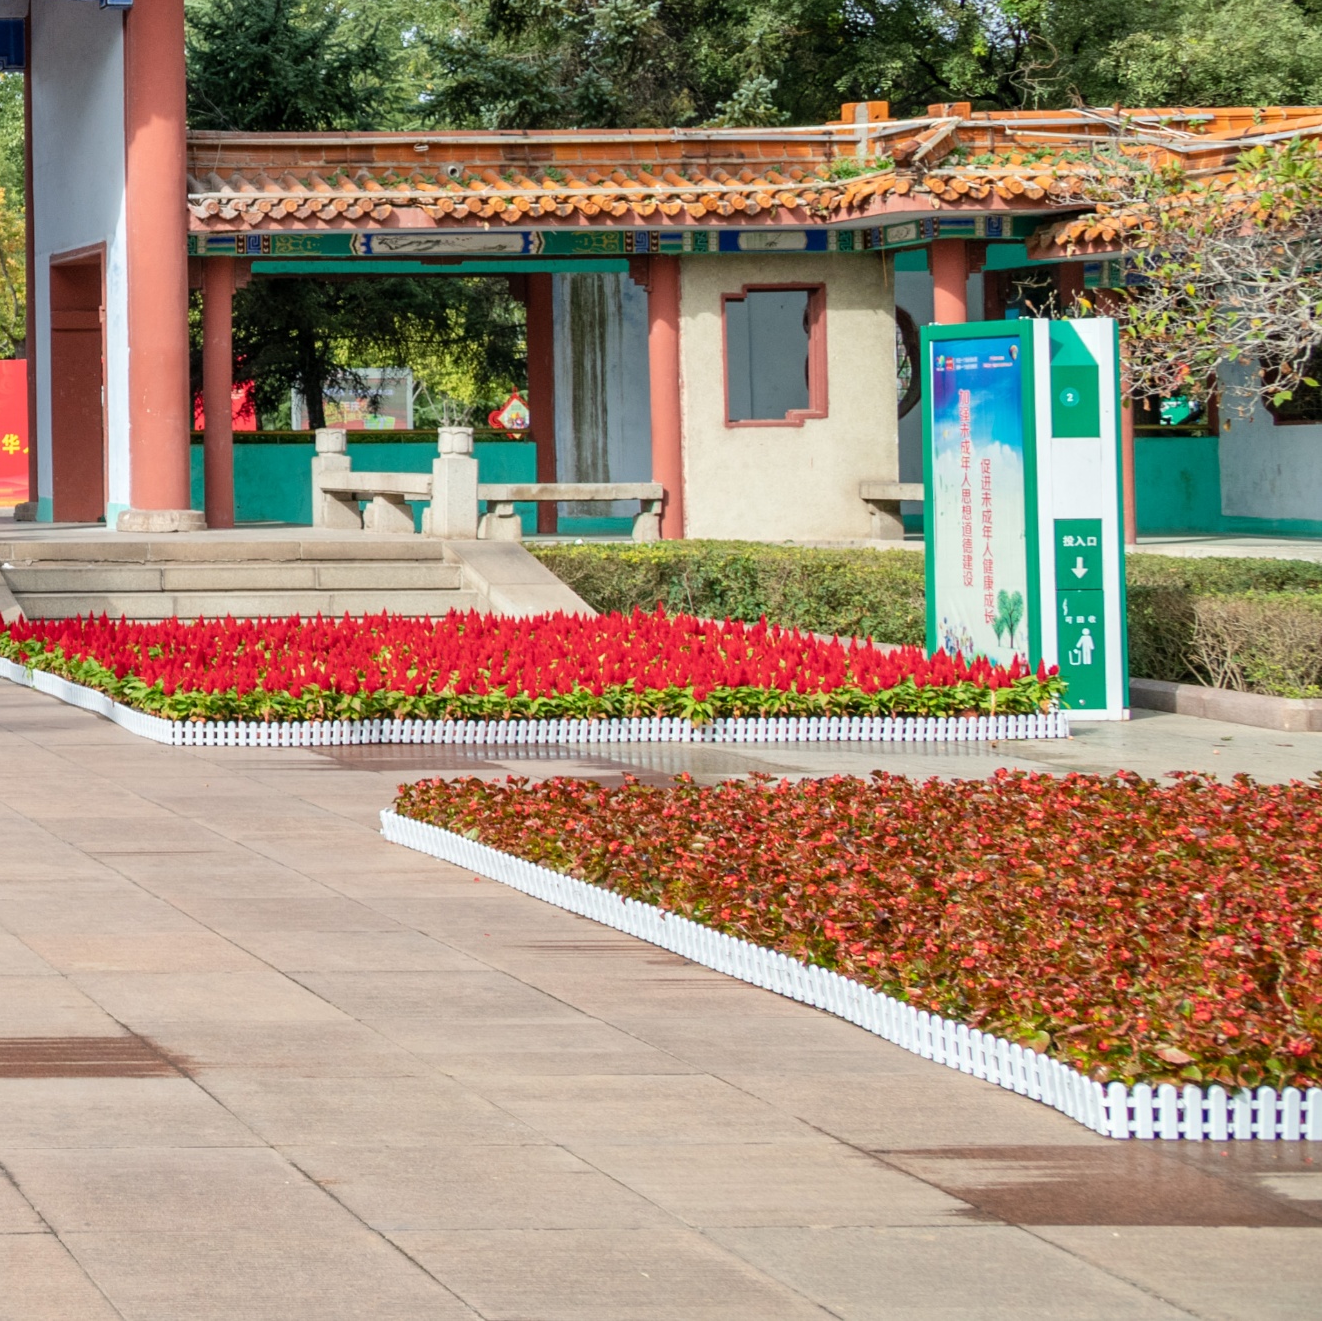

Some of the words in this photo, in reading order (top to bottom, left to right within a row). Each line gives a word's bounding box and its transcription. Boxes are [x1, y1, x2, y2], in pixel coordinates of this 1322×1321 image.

[1065, 392, 1075, 402] 2
[958, 389, 973, 587] 加强未成年人思想道德建设
[980, 458, 996, 624] 促进未成年人健康成长
[1062, 535, 1098, 547] 投入口
[1064, 615, 1097, 624] 可回收
